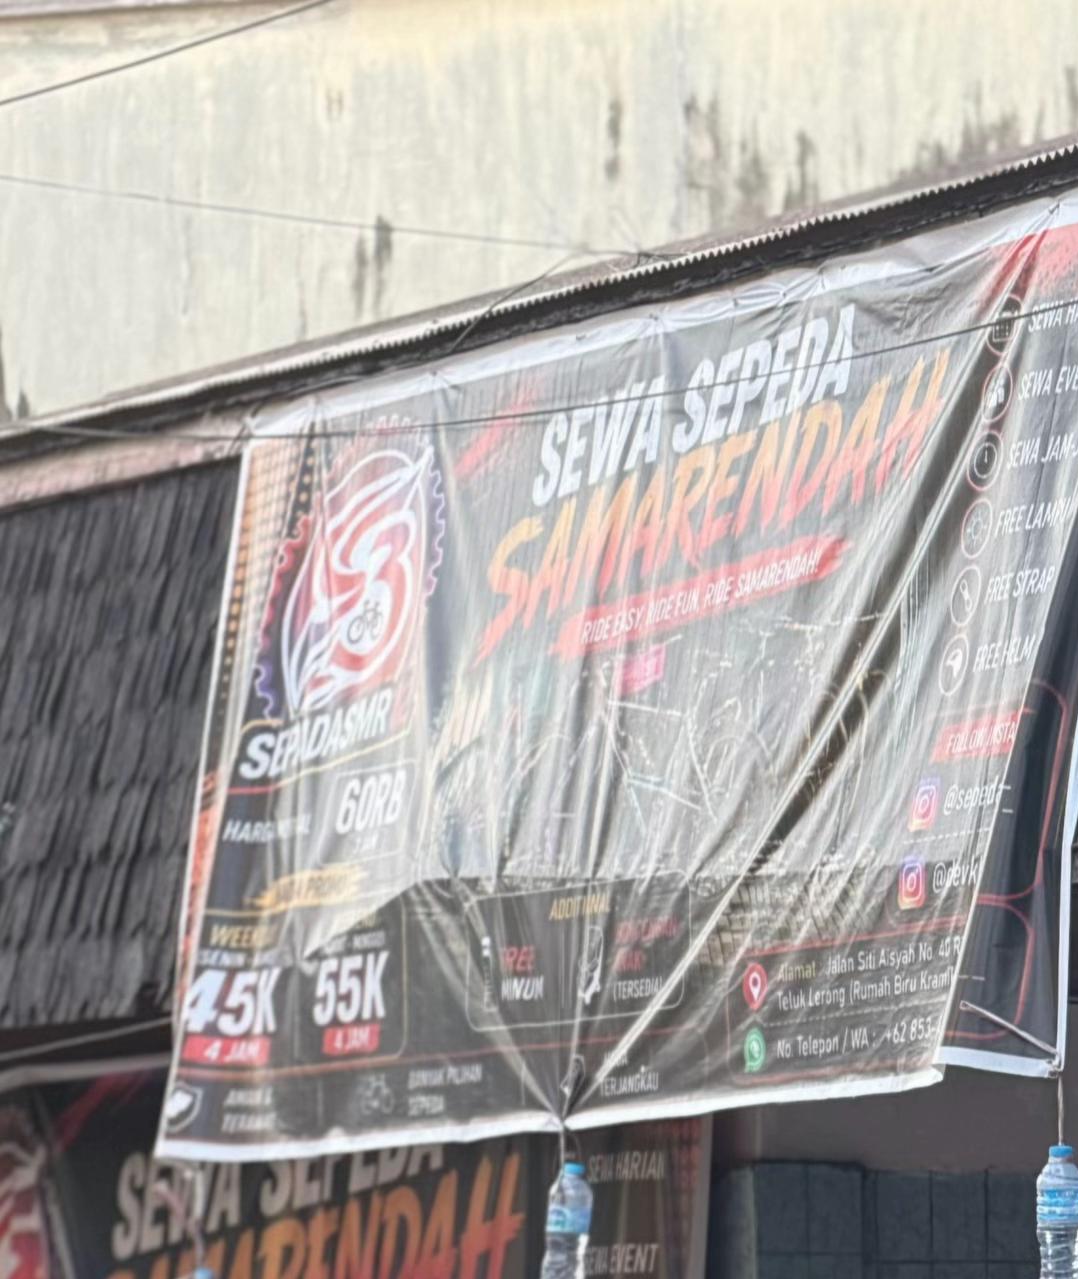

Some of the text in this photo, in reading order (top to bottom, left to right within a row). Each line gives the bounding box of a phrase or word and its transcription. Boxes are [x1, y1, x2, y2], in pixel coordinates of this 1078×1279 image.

[1028, 301, 1063, 333] SEWA
[1018, 368, 1053, 401] SEWA
[532, 304, 856, 507] SEWA SEPEDA
[1007, 436, 1041, 470] SEWA
[474, 347, 951, 665] SAMARENDAH
[994, 504, 1027, 539] FREE
[581, 616, 611, 645] RIDE
[704, 579, 733, 607] RIDE
[735, 550, 822, 598] SAMARENDAH!
[984, 571, 1015, 605] FREE
[973, 641, 1002, 673] FREE
[778, 960, 816, 984] Alamat
[825, 953, 855, 977] Jalan
[858, 950, 877, 972] Siti
[879, 944, 916, 972] Aisyah
[182, 966, 283, 1037] 45K
[312, 950, 391, 1027] 55K
[501, 975, 544, 1001] MINUM
[777, 990, 806, 1012] Teluk
[808, 985, 846, 1010] Lerong
[849, 978, 892, 1007] (Rumah
[893, 974, 918, 995] Biru
[203, 1040, 261, 1063] 4 JAM
[797, 1031, 840, 1059] Telepon
[850, 1028, 870, 1048] WA
[884, 1021, 907, 1046] +62
[615, 1151, 666, 1182] HARIAN
[609, 1243, 659, 1275] EVENT
